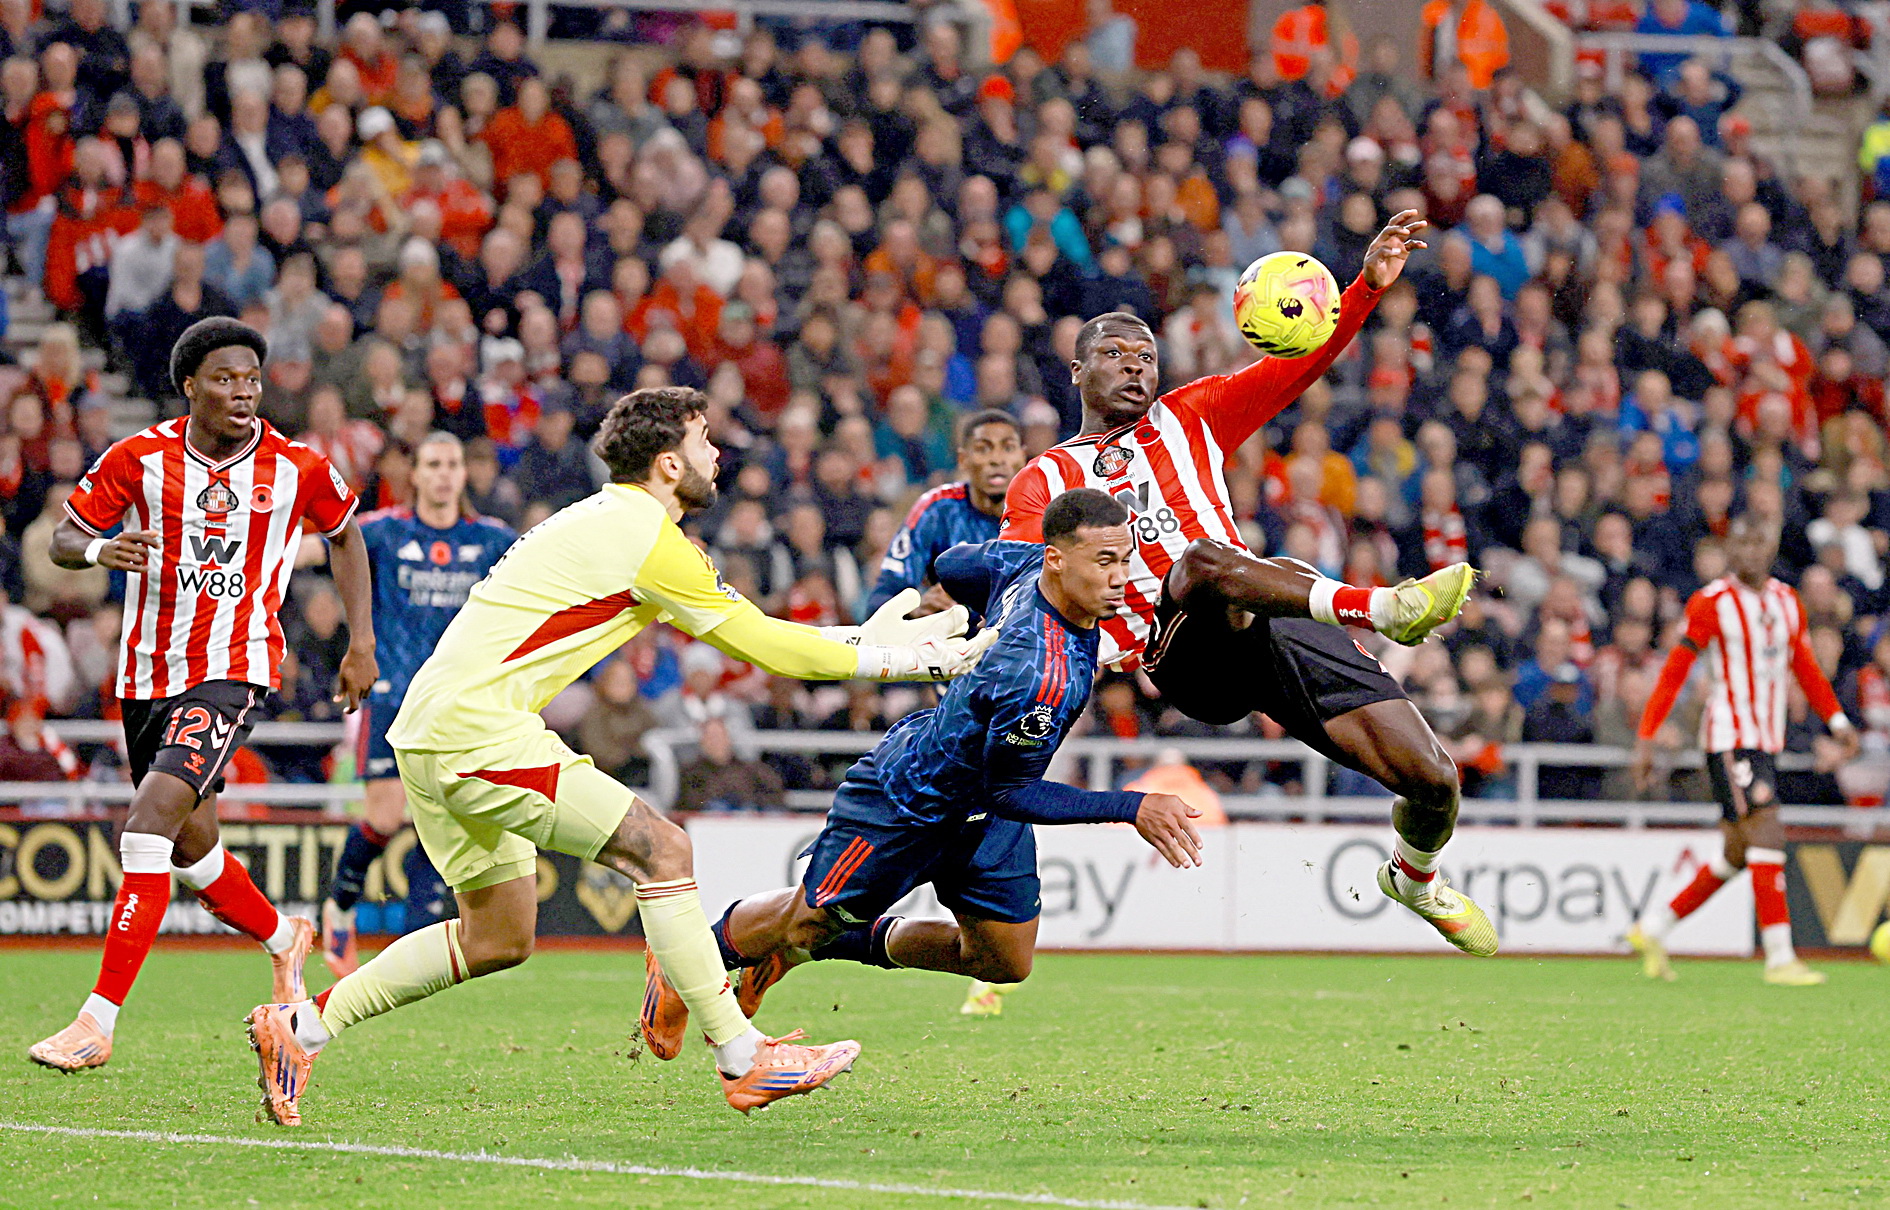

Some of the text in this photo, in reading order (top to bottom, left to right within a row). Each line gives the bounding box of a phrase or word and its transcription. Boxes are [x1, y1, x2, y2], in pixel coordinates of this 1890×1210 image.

[1131, 507, 1178, 550] 88
[178, 568, 243, 598] W88
[165, 706, 212, 751] 12
[1325, 836, 1661, 944] Crpay
[117, 893, 139, 931] SAFC
